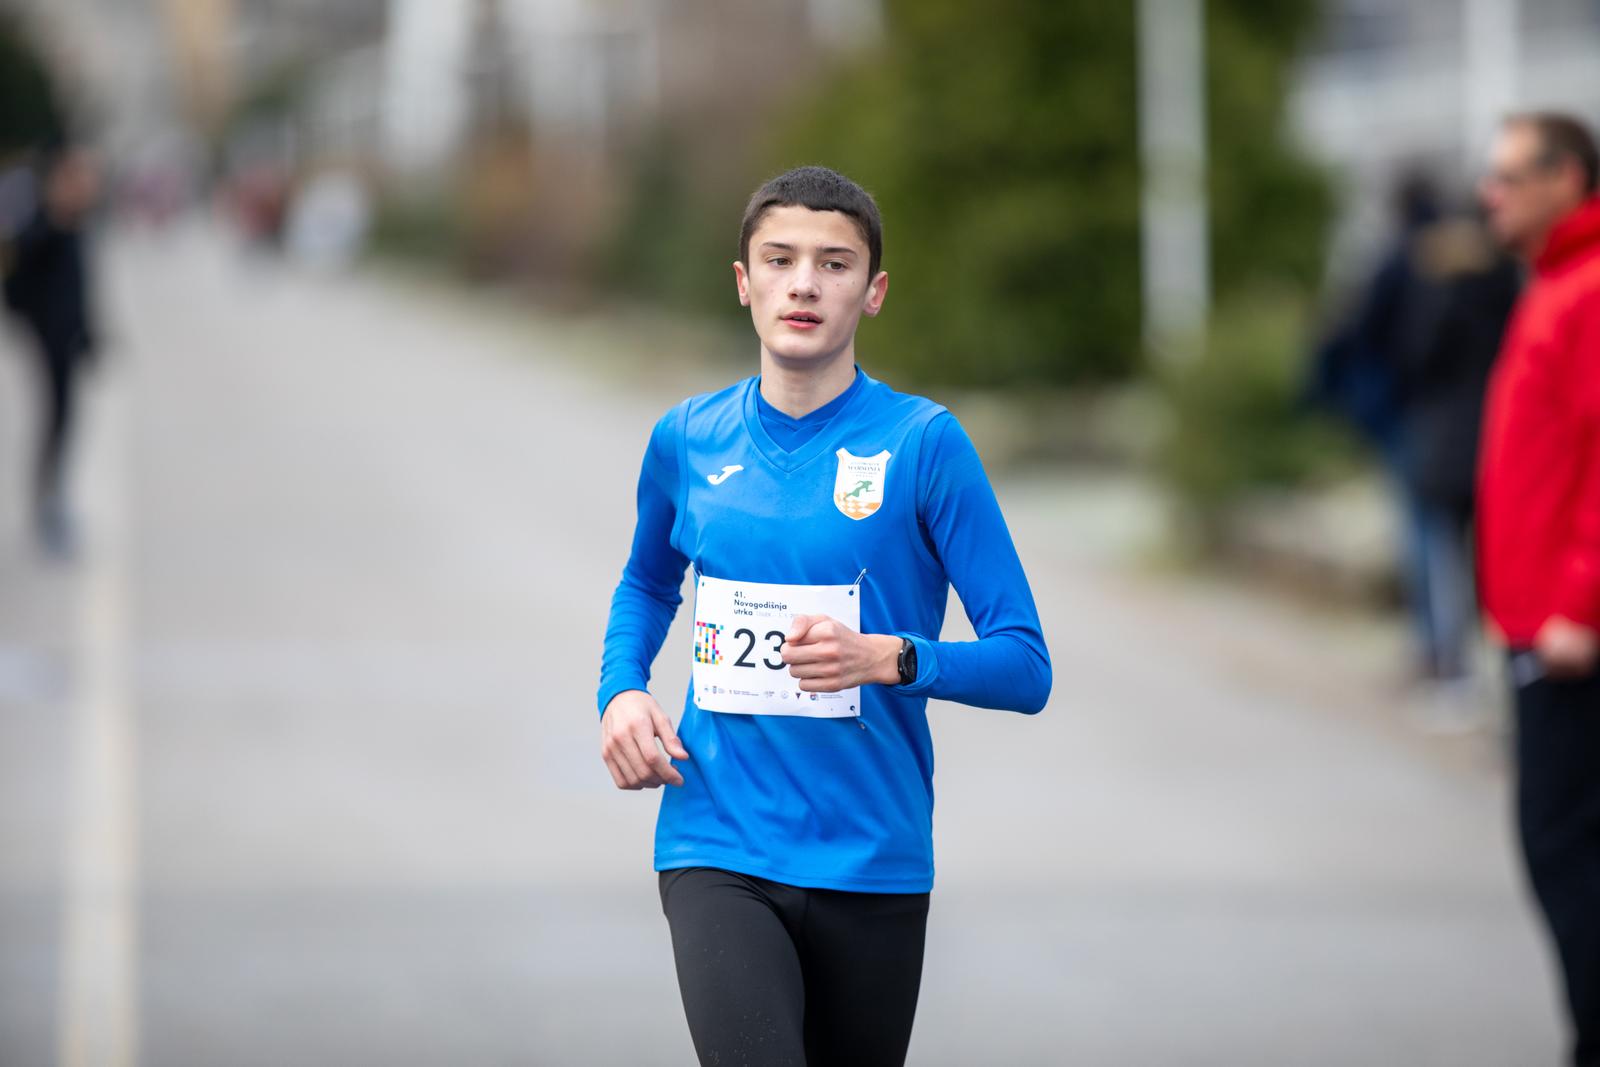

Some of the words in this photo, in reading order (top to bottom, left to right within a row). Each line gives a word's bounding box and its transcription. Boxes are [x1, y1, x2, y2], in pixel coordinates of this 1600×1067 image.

[734, 591, 746, 599] 41.
[734, 599, 787, 611] Novogodišnja
[734, 608, 753, 616] utrka
